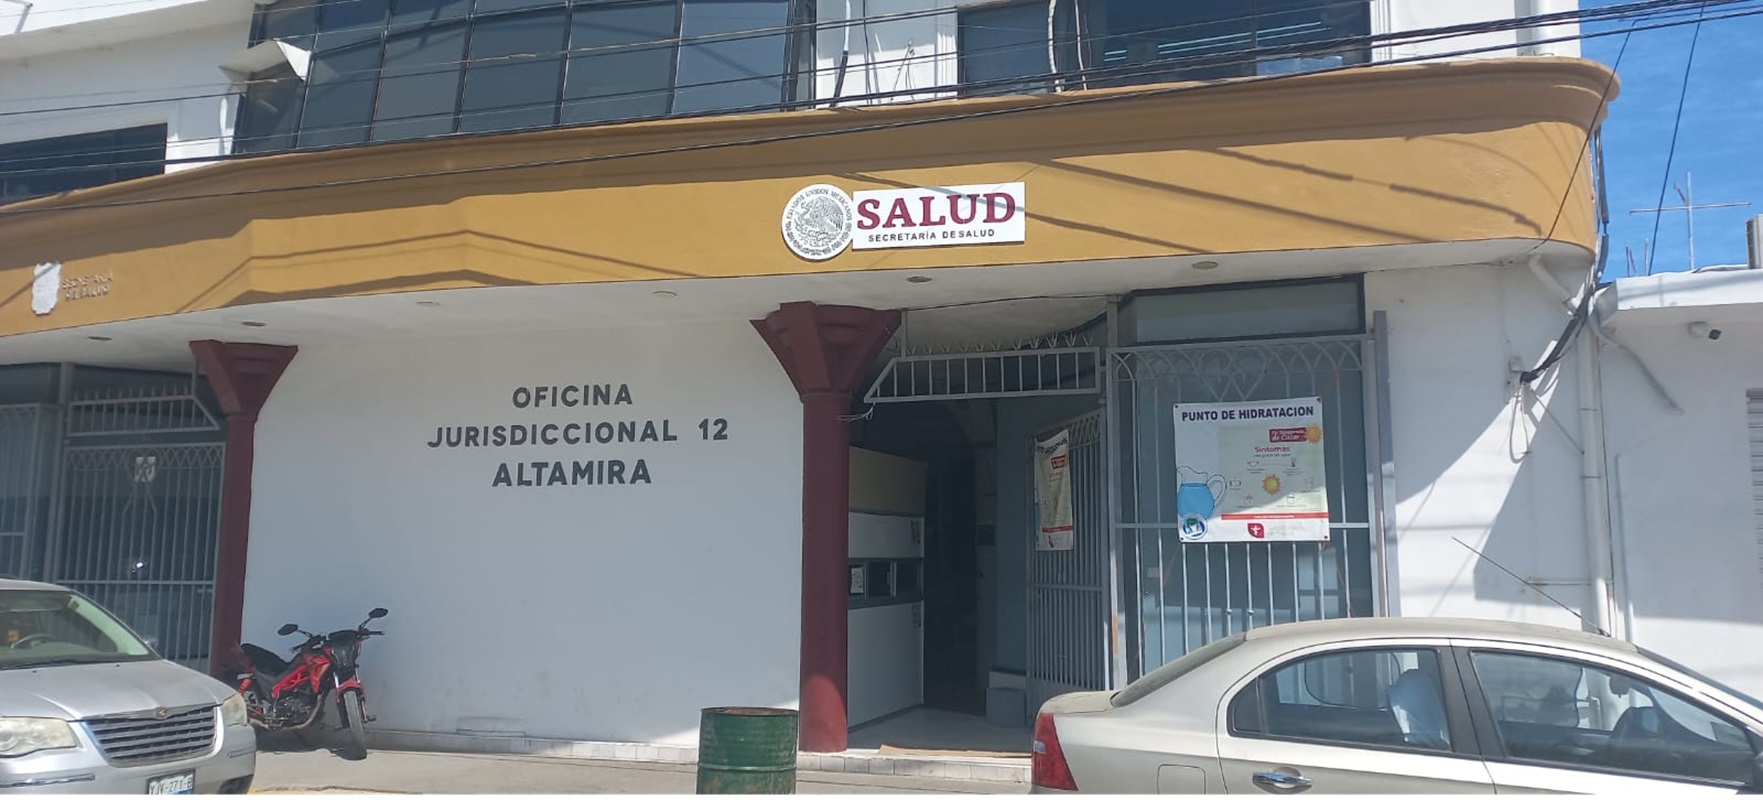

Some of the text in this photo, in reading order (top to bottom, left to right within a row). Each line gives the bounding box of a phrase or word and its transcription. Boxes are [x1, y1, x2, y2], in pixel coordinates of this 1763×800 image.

[857, 192, 1016, 229] SALUD
[868, 231, 936, 242] SECRETARÍA
[512, 384, 633, 408] OFICINA
[1181, 406, 1314, 421] PUNTO DE HIDRATACION
[427, 418, 728, 448] JURISDICCIONAL 12
[492, 459, 652, 487] ALTAMIRA
